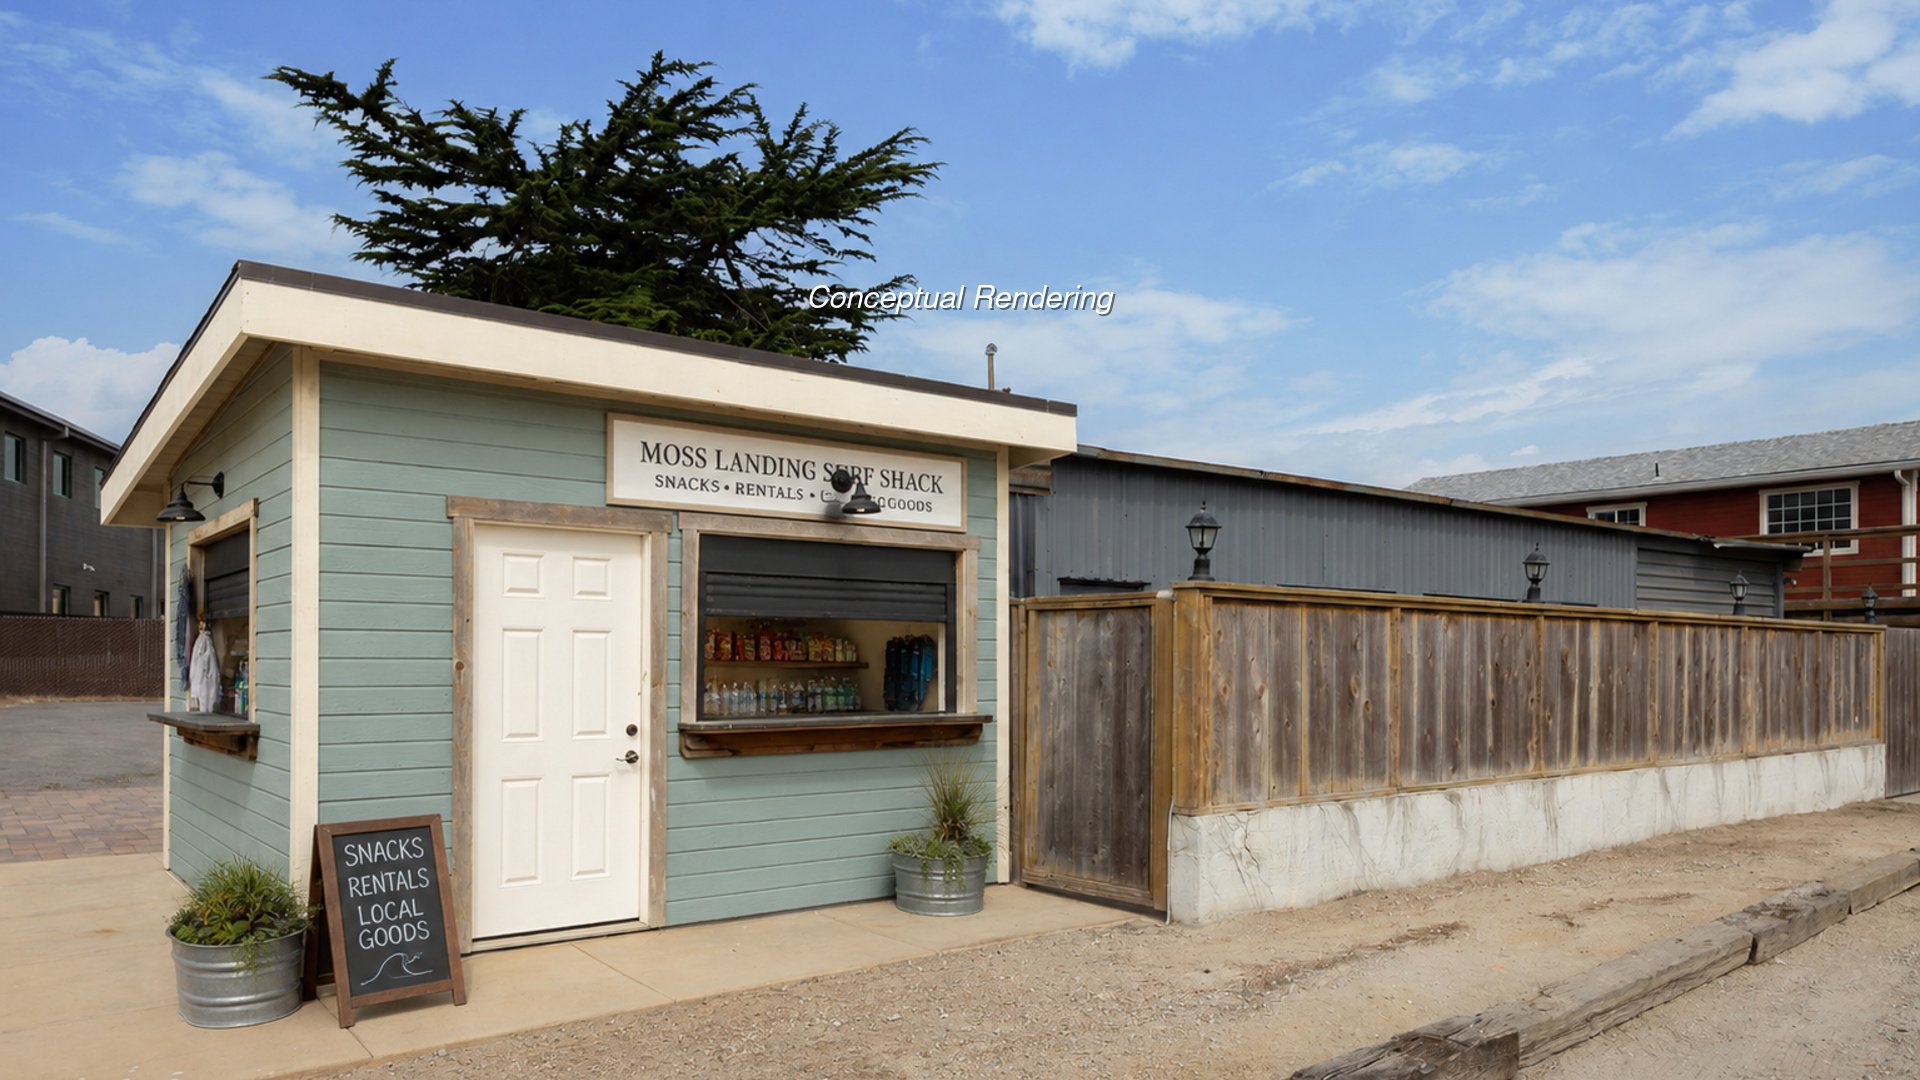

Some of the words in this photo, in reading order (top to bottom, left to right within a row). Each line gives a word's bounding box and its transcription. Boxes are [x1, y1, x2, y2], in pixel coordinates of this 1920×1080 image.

[640, 441, 707, 469] MOSS
[715, 449, 816, 481] LANDING
[823, 462, 874, 486] SRF
[880, 468, 944, 494] SHACK
[655, 474, 720, 493] SNACKS
[735, 482, 804, 500] RENTALS
[344, 836, 425, 867] SNACKS
[348, 867, 430, 898] RENTALS
[357, 898, 424, 926] LOCAL
[359, 920, 430, 950] GOODS
